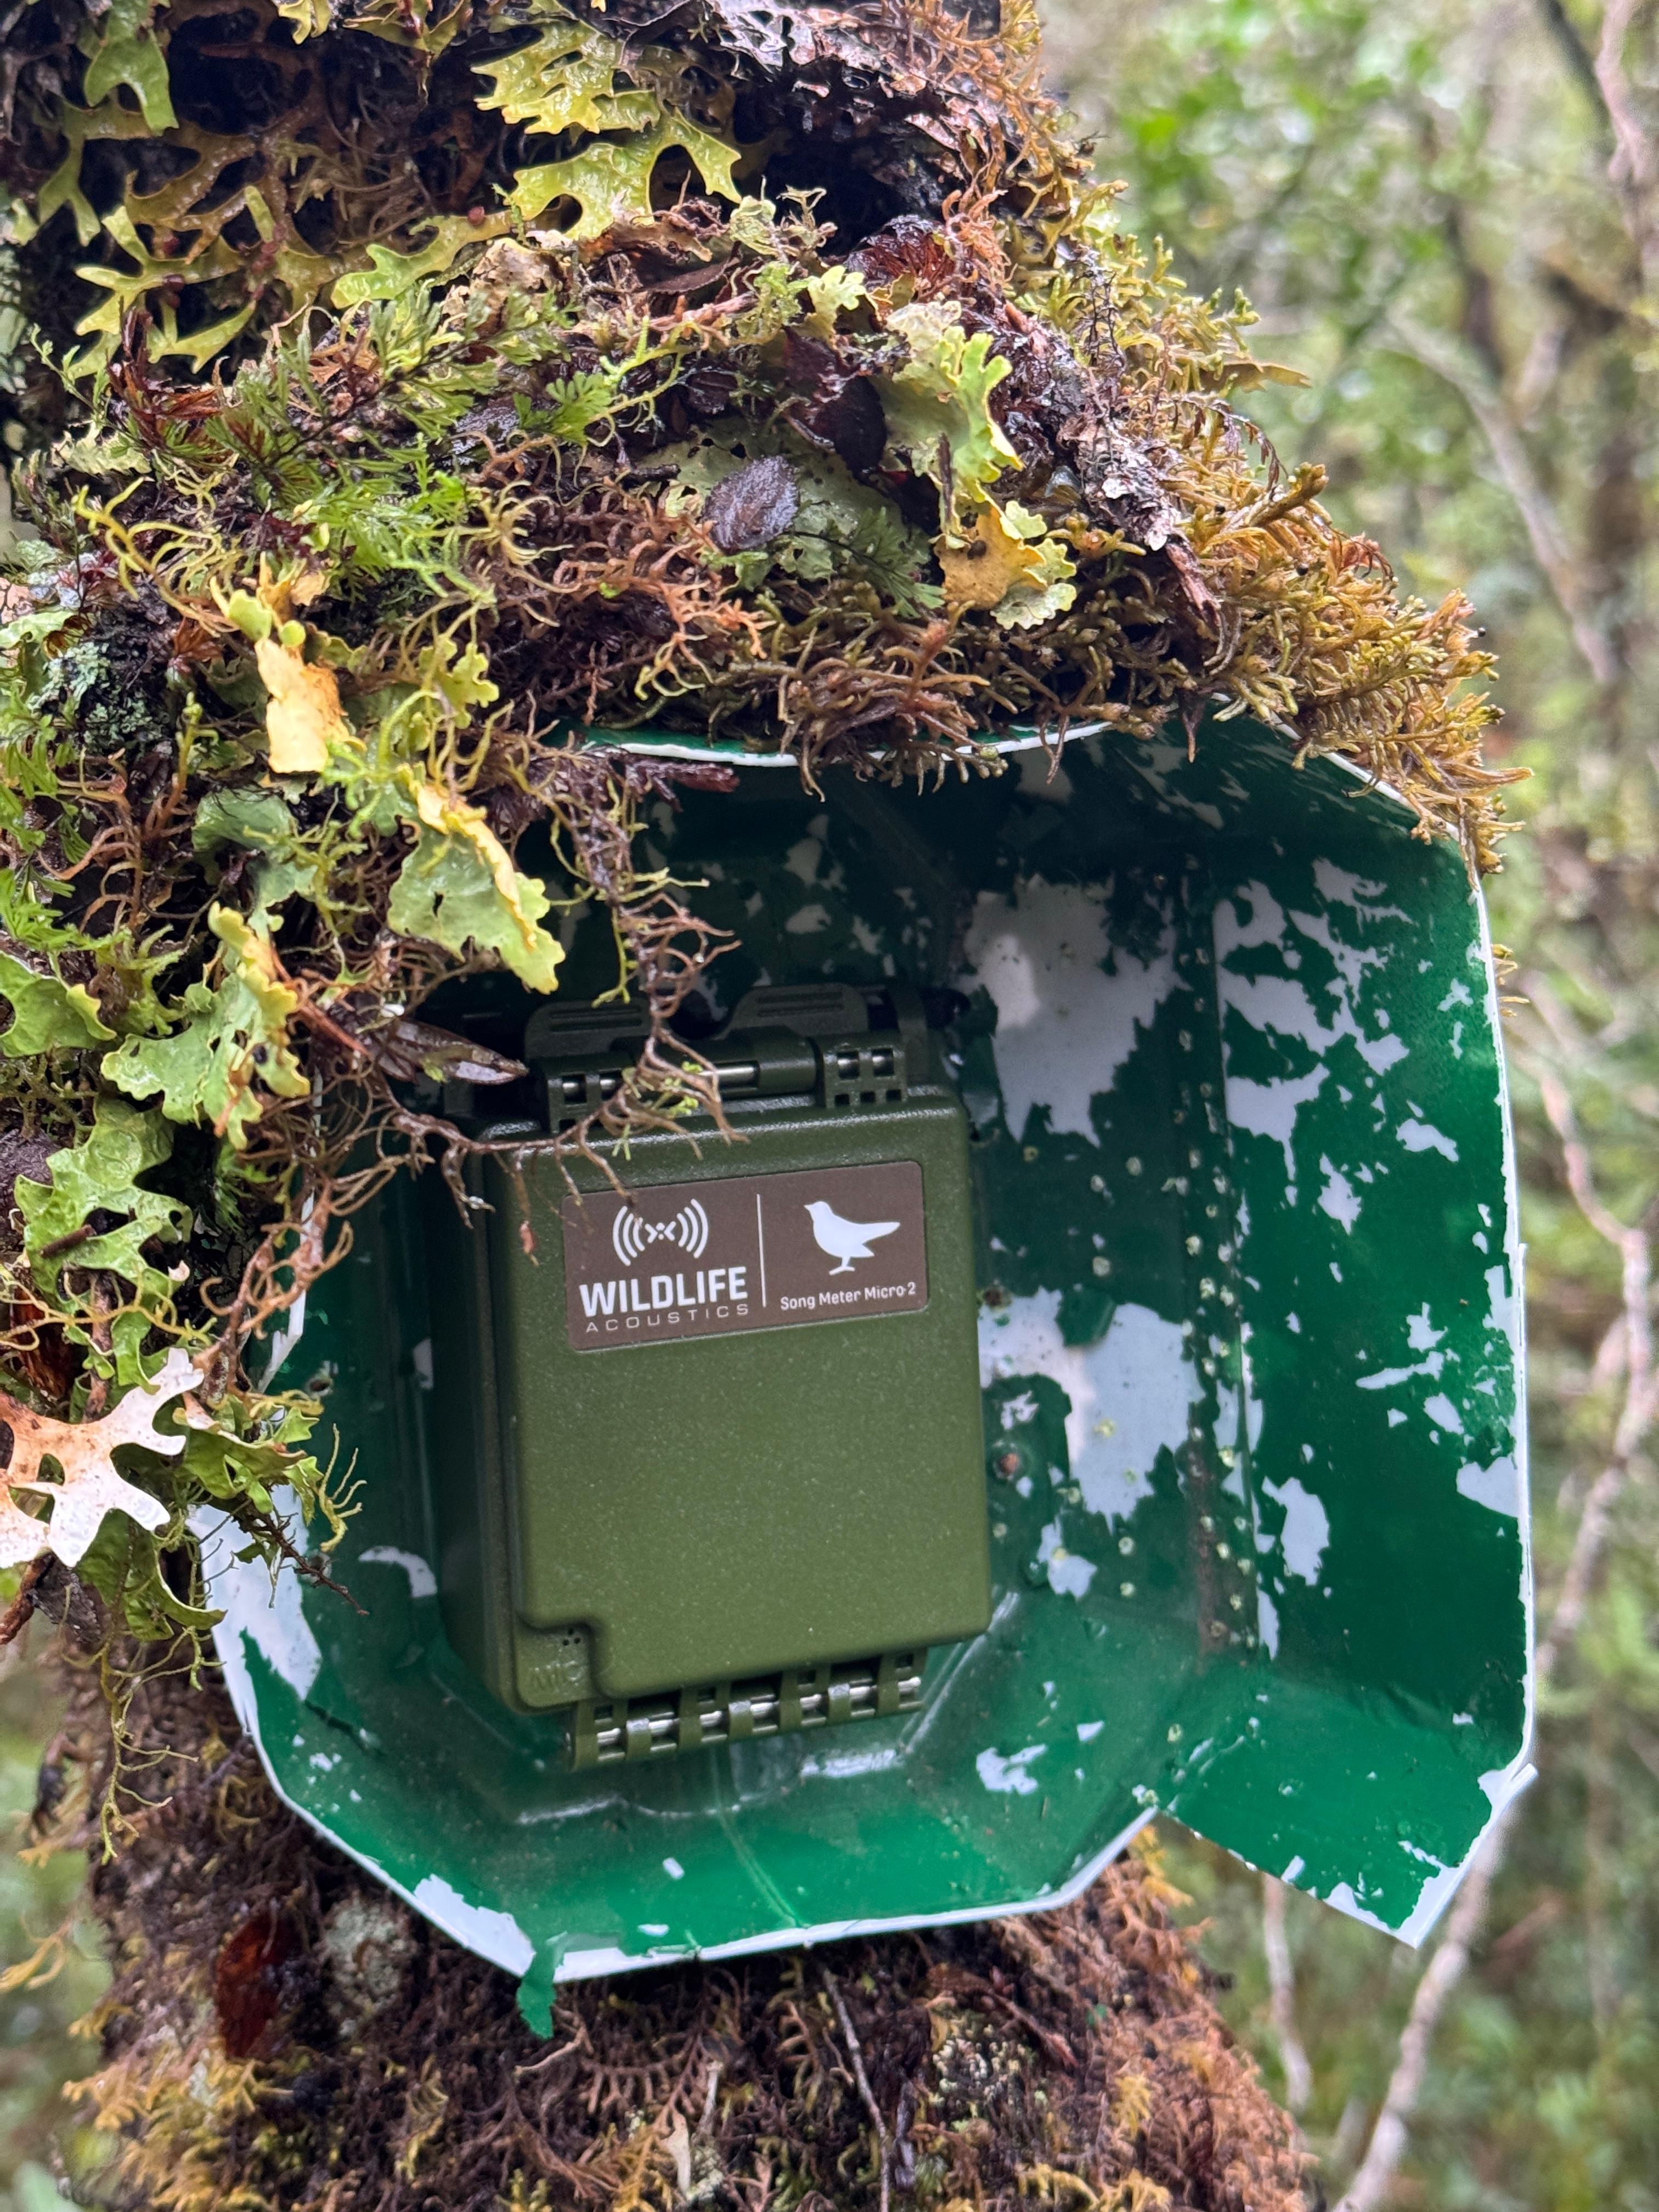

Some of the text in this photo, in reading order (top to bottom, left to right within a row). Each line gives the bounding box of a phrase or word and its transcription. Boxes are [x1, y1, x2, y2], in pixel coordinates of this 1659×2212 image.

[579, 1266, 748, 1317] WILDLIFE
[780, 1282, 917, 1311] Song Meter Micro 2
[585, 1304, 749, 1333] ACOUSTICS
